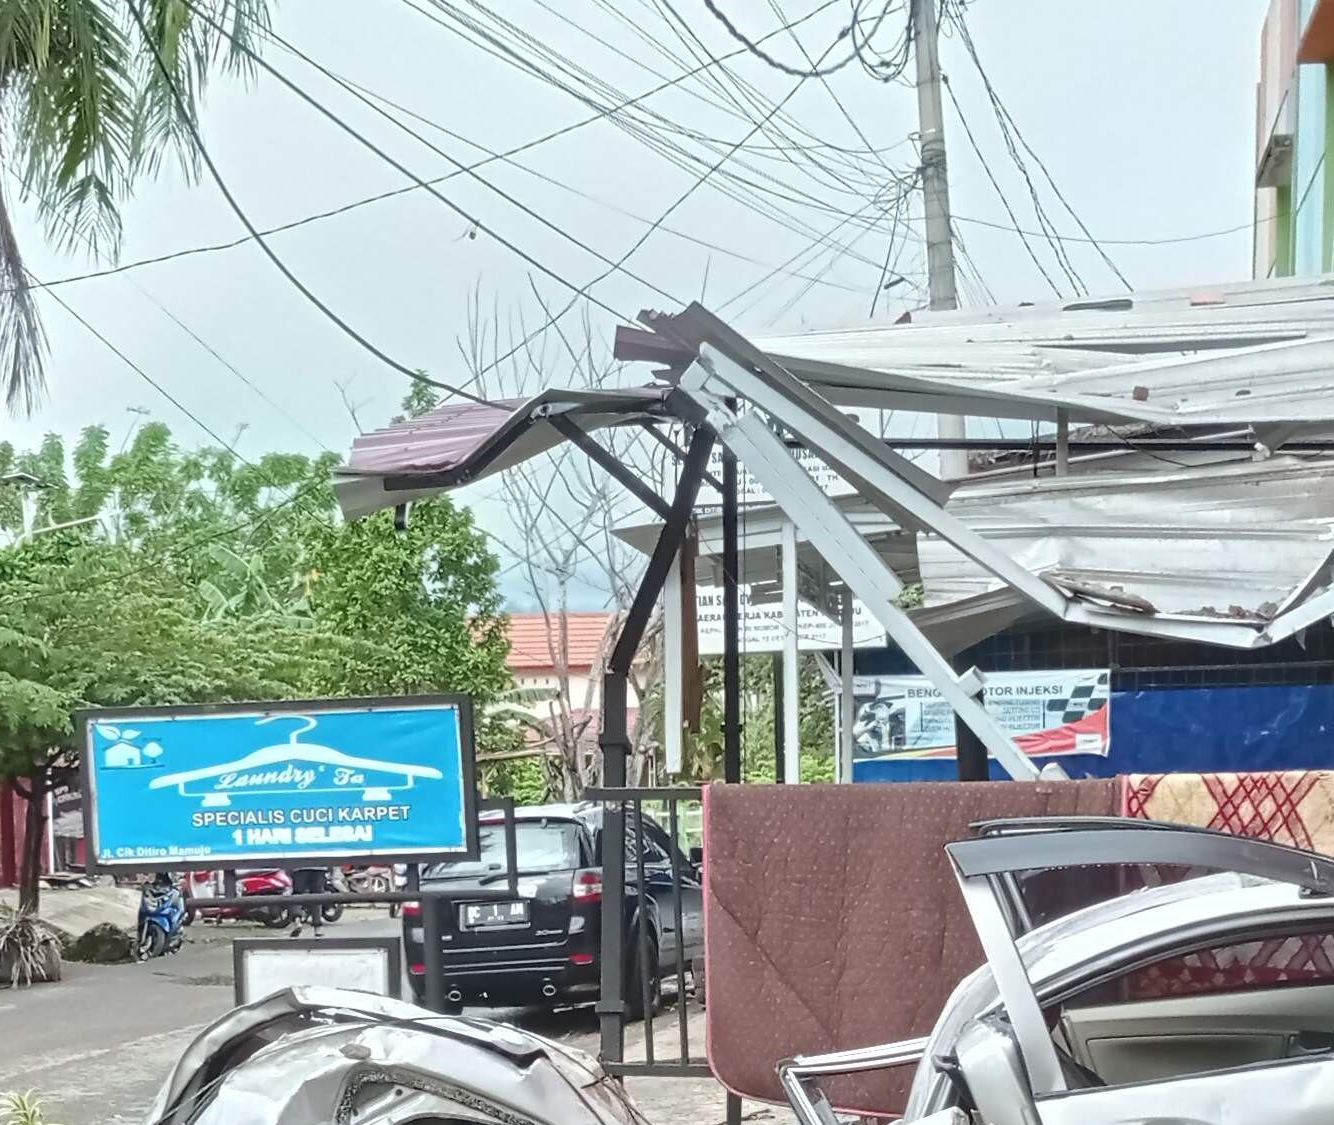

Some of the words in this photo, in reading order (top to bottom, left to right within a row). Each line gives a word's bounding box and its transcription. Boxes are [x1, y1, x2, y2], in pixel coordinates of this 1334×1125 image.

[907, 687, 942, 698] BENG
[1016, 684, 1063, 696] INJEKSI
[192, 810, 285, 827] SPECIALIS
[290, 807, 333, 824] CUCI
[338, 805, 410, 822] KARPET
[232, 829, 243, 845] 1
[247, 828, 292, 844] HARI
[294, 825, 373, 843] SELESAI
[136, 846, 167, 857] Ditiro
[168, 844, 211, 857] Mamuju
